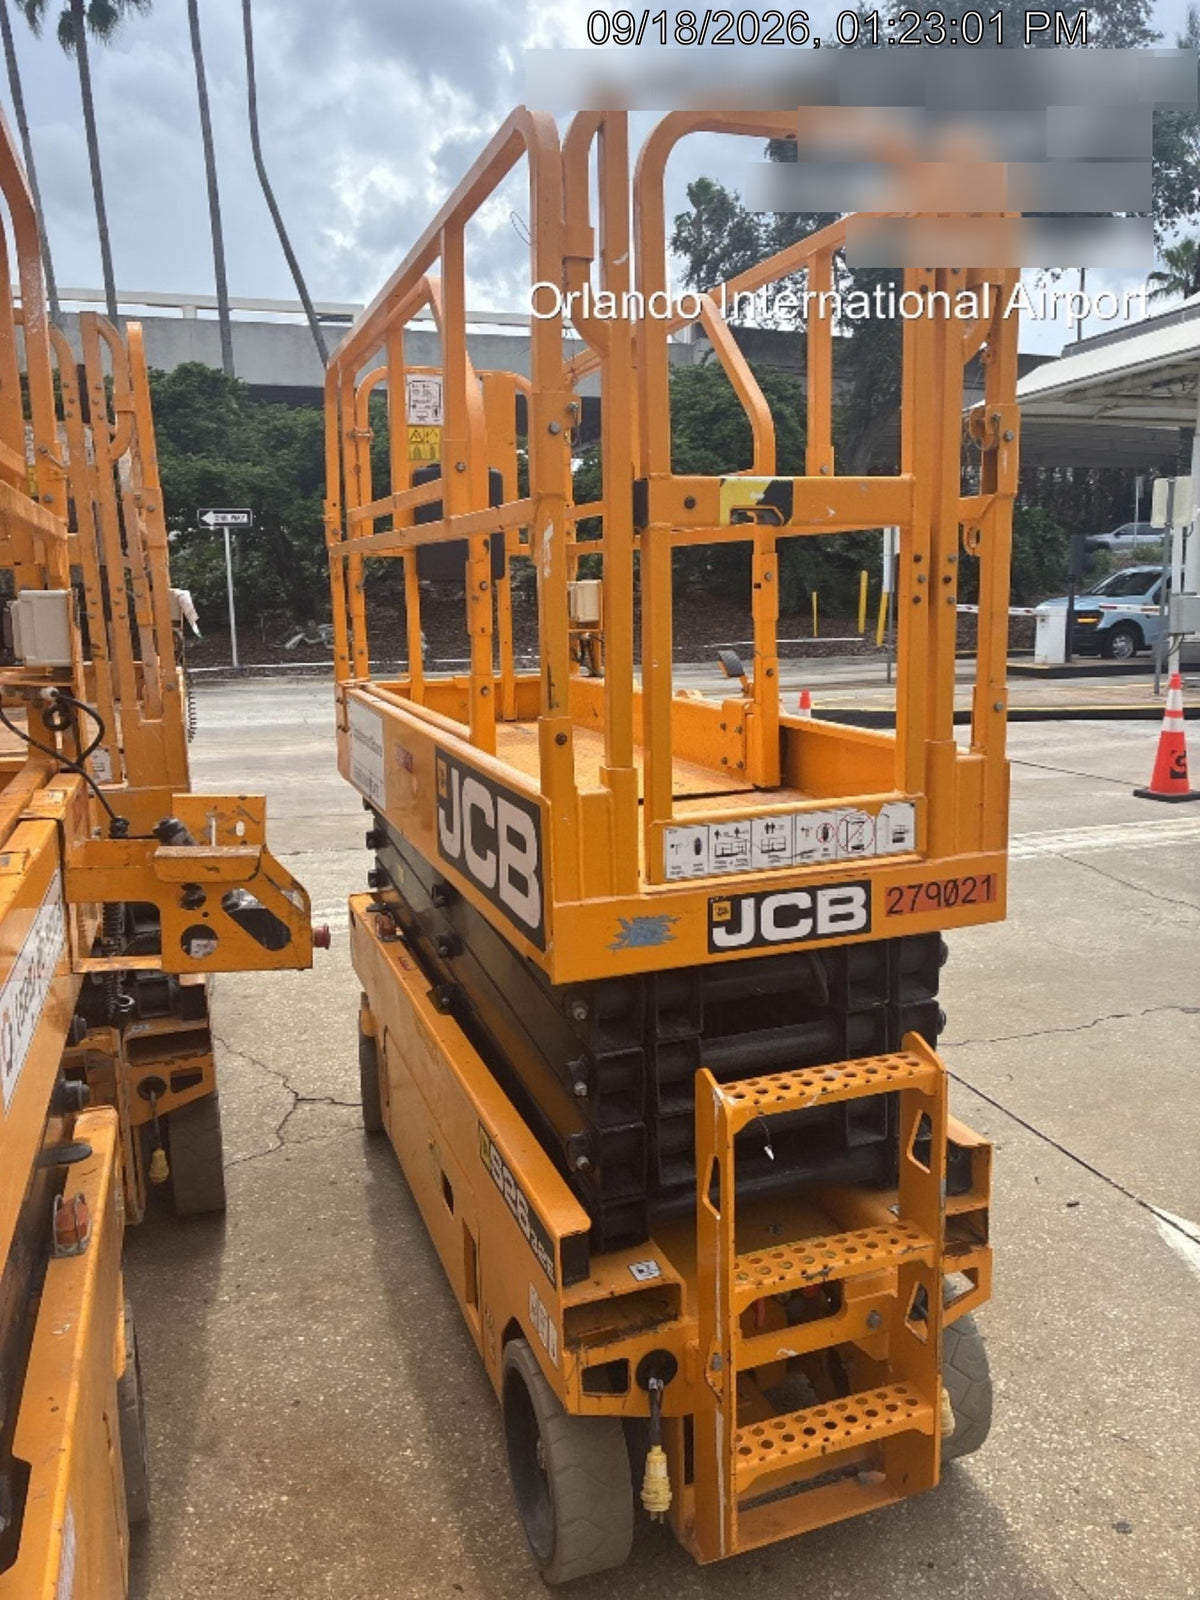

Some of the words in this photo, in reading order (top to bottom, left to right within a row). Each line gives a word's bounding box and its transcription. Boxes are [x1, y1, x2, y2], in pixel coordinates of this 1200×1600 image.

[438, 767, 542, 929] JCB
[712, 886, 867, 947] JCB
[887, 873, 993, 915] 279021
